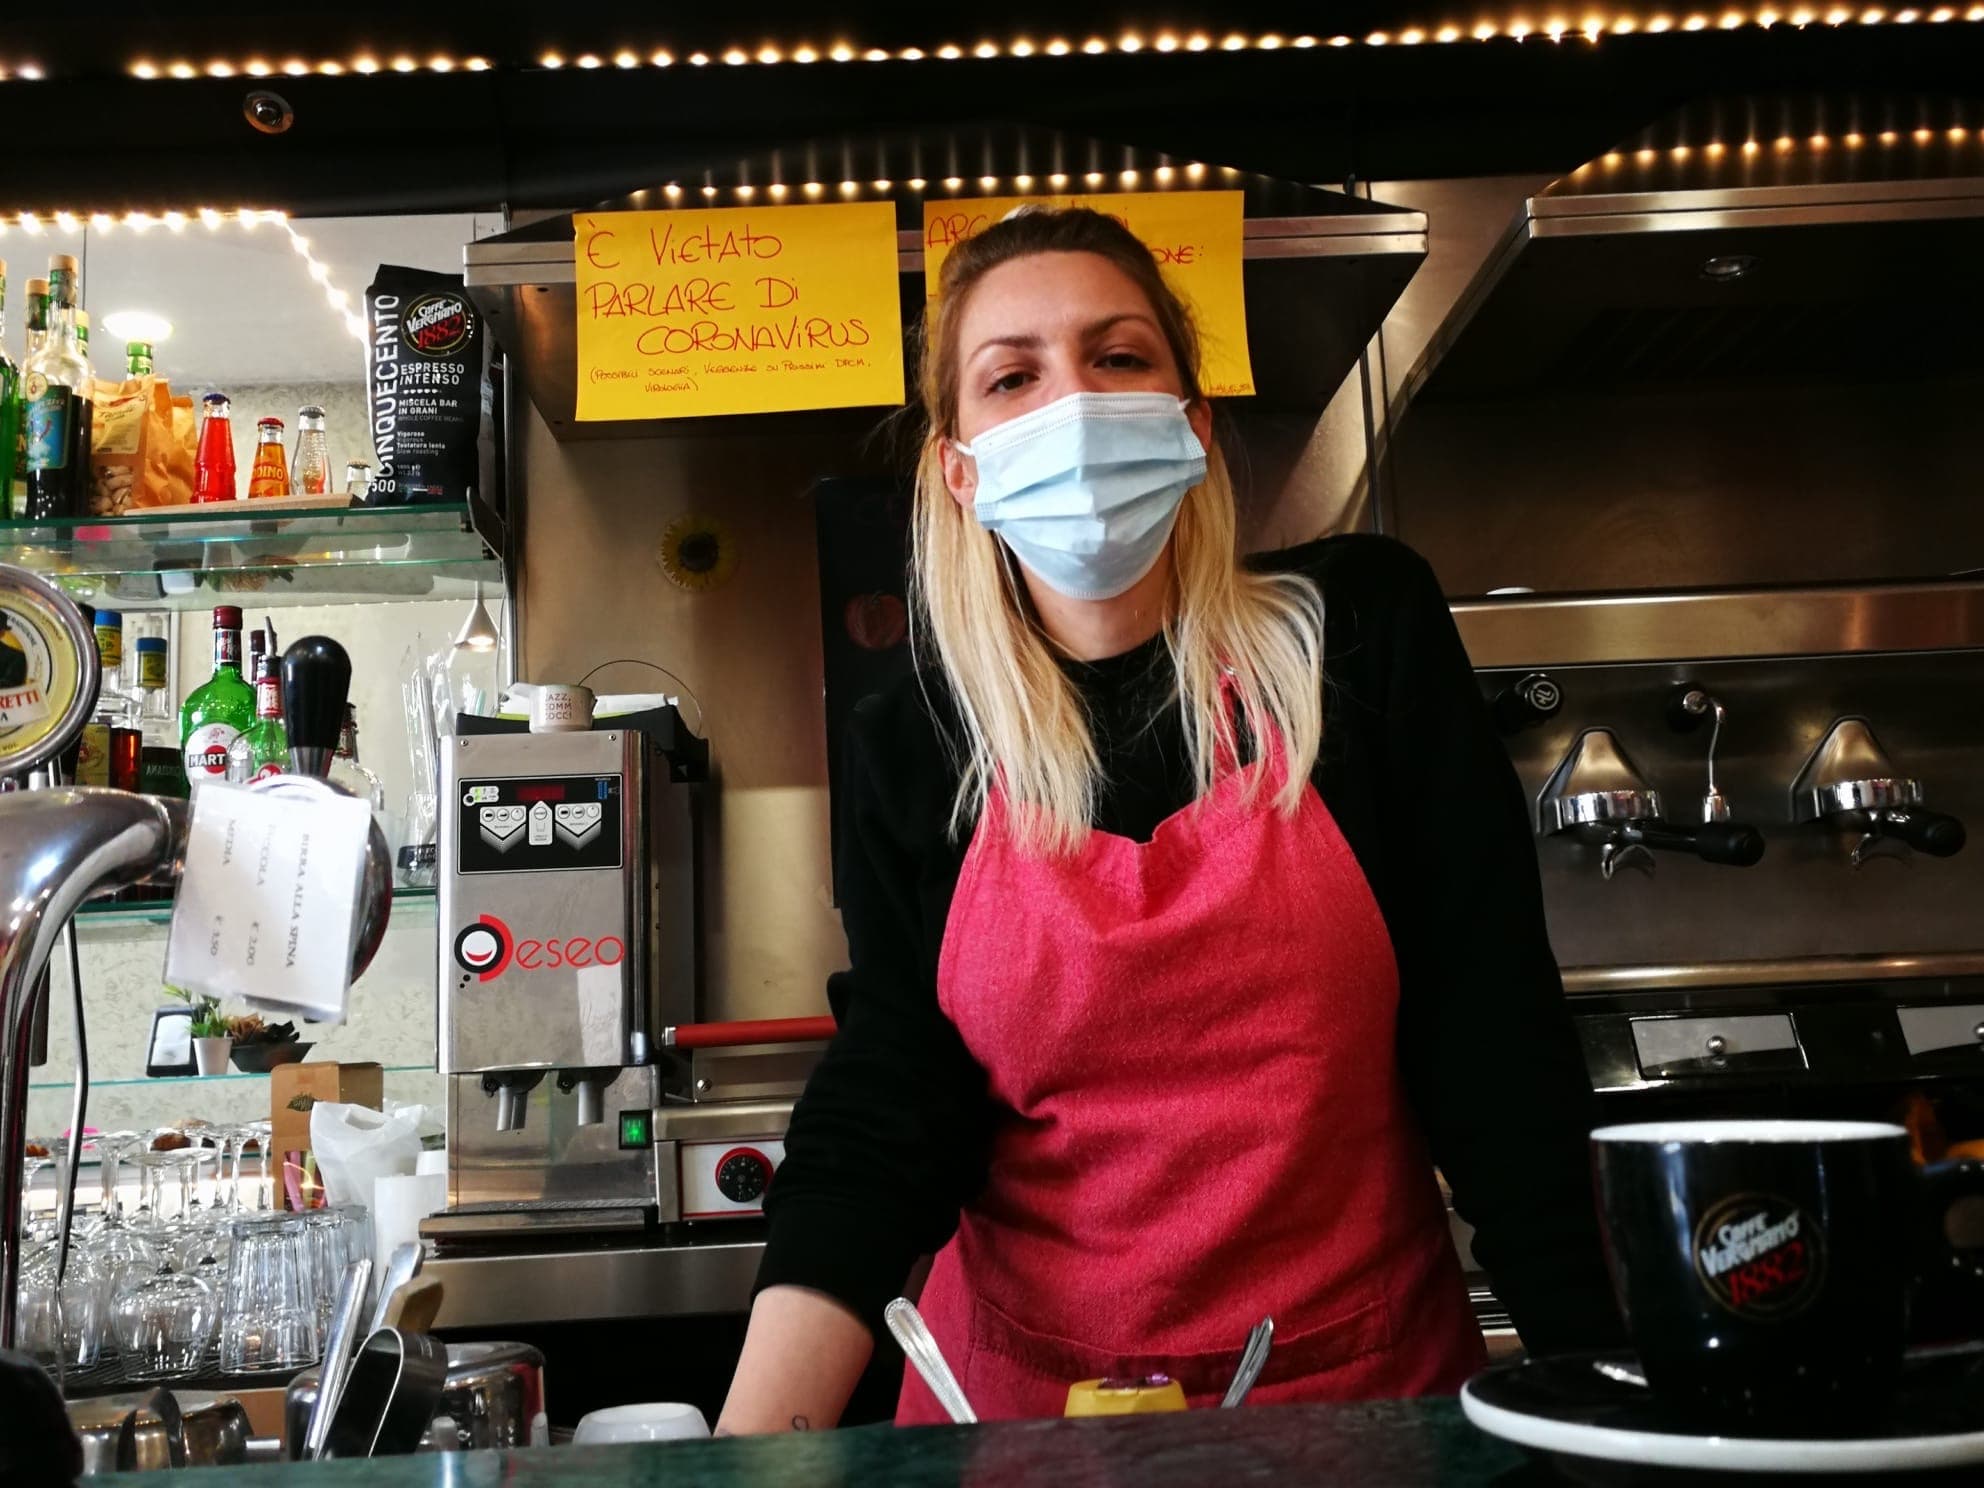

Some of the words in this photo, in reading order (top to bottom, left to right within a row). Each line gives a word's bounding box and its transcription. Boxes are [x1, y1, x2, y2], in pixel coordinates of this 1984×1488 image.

[584, 277, 736, 320] PARLARE
[416, 314, 462, 350] 1882
[400, 361, 465, 375] ESPRESSO
[400, 372, 460, 386] INTENSO
[374, 294, 399, 478] CINQUECENTO
[398, 398, 437, 407] MISCELA
[439, 399, 458, 408] BAR
[398, 407, 408, 415] IN
[371, 478, 396, 493] 500
[293, 885, 306, 920] ALLA
[286, 925, 299, 968] SPINA
